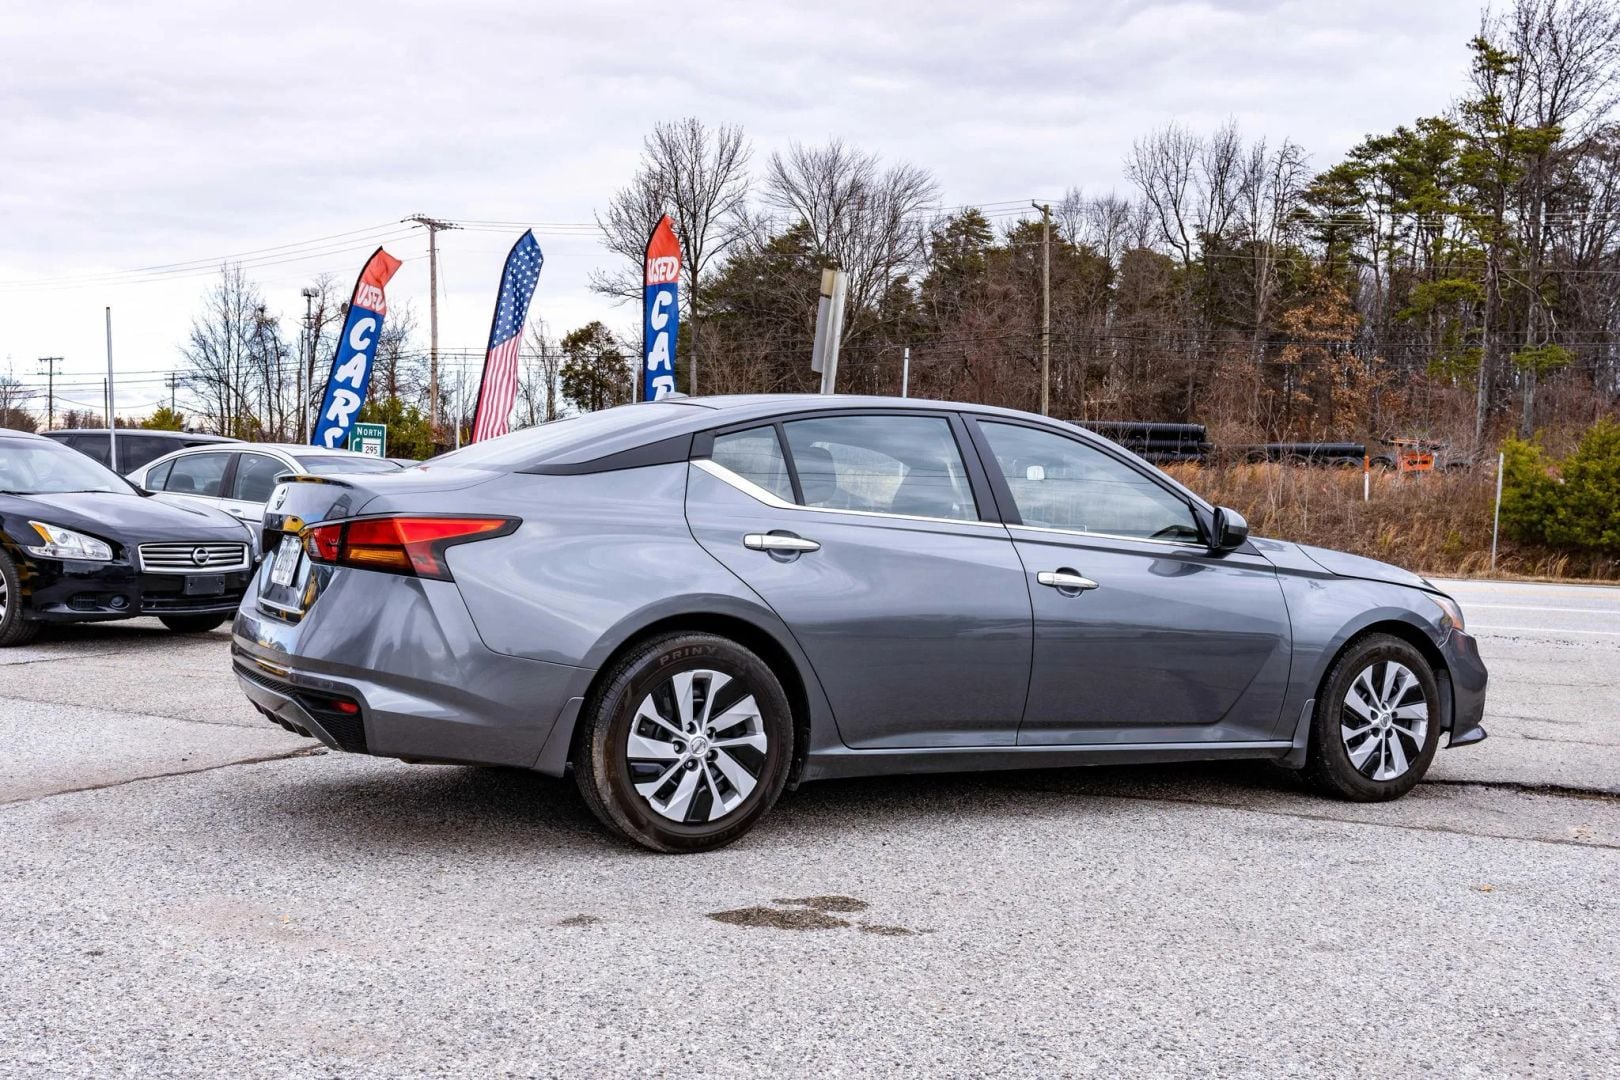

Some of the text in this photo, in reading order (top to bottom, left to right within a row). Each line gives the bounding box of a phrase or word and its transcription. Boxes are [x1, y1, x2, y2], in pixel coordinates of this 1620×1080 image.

[647, 256, 679, 283] USED
[356, 426, 382, 437] NORTH
[365, 445, 378, 455] 295
